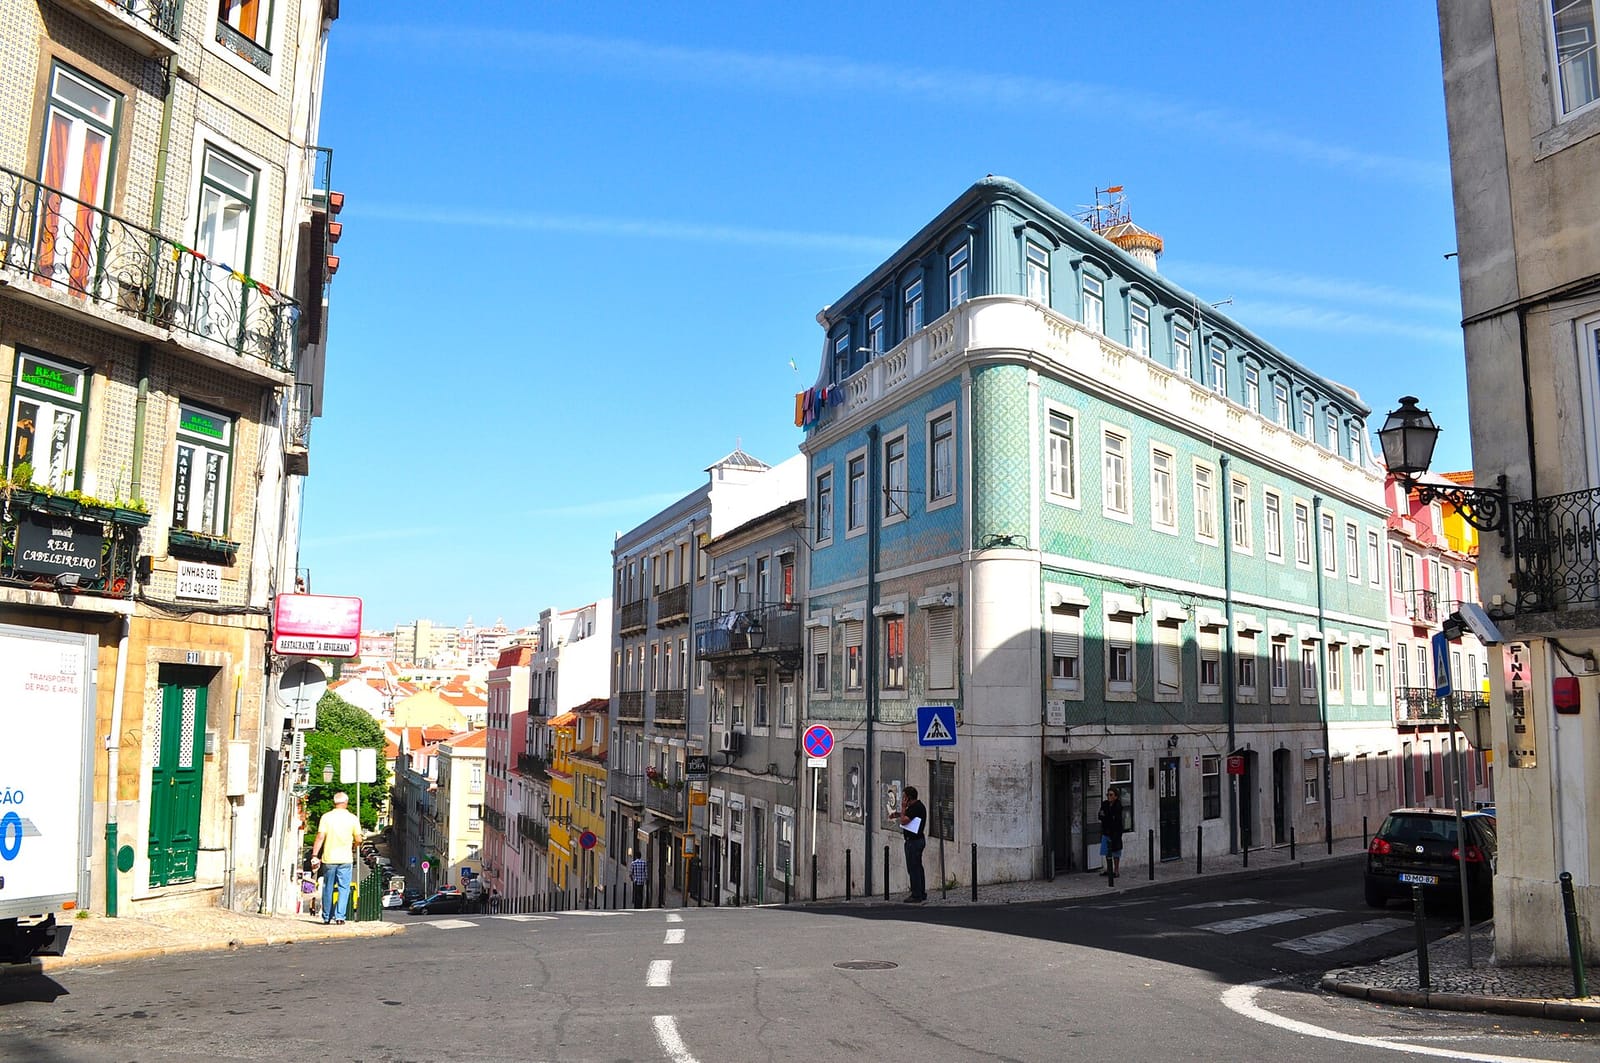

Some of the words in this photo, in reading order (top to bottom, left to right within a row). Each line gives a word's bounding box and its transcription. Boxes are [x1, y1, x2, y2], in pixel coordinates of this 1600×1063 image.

[35, 366, 63, 382] REAL
[176, 448, 189, 520] MANICURE
[47, 539, 75, 552] REAL
[23, 550, 97, 569] CABELEIREIRO
[182, 565, 204, 578] UNHAS
[206, 568, 218, 580] GEL
[30, 672, 75, 684] TRANSPORTE
[1510, 645, 1526, 734] FINALMENTE
[0, 786, 24, 804] ÃO
